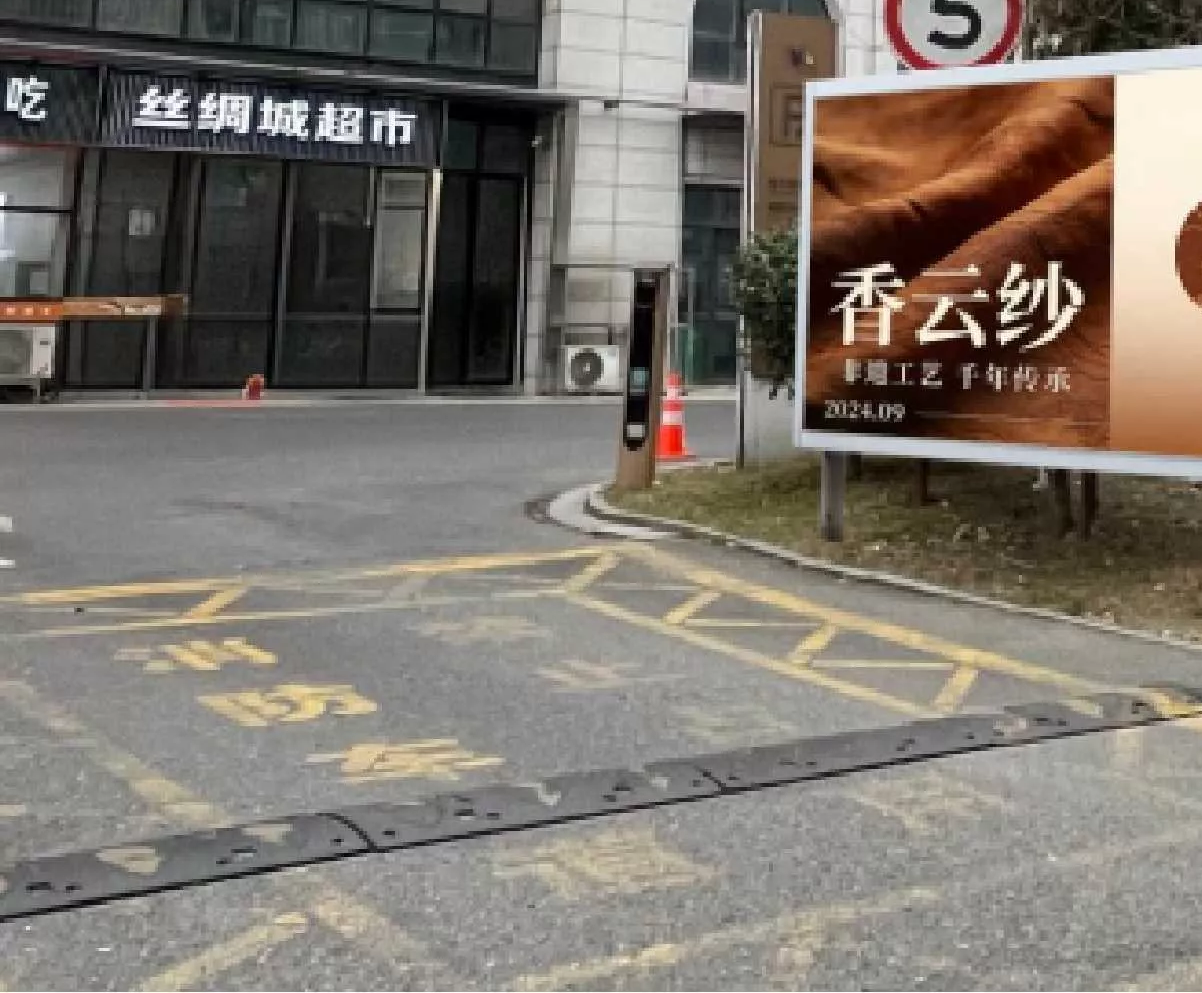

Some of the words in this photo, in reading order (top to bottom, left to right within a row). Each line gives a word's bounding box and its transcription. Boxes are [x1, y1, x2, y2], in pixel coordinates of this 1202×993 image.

[6, 75, 50, 122] 吃
[132, 84, 419, 148] 丝绸城超市
[830, 261, 1086, 353] 香云纱
[824, 399, 906, 422] 2024.09
